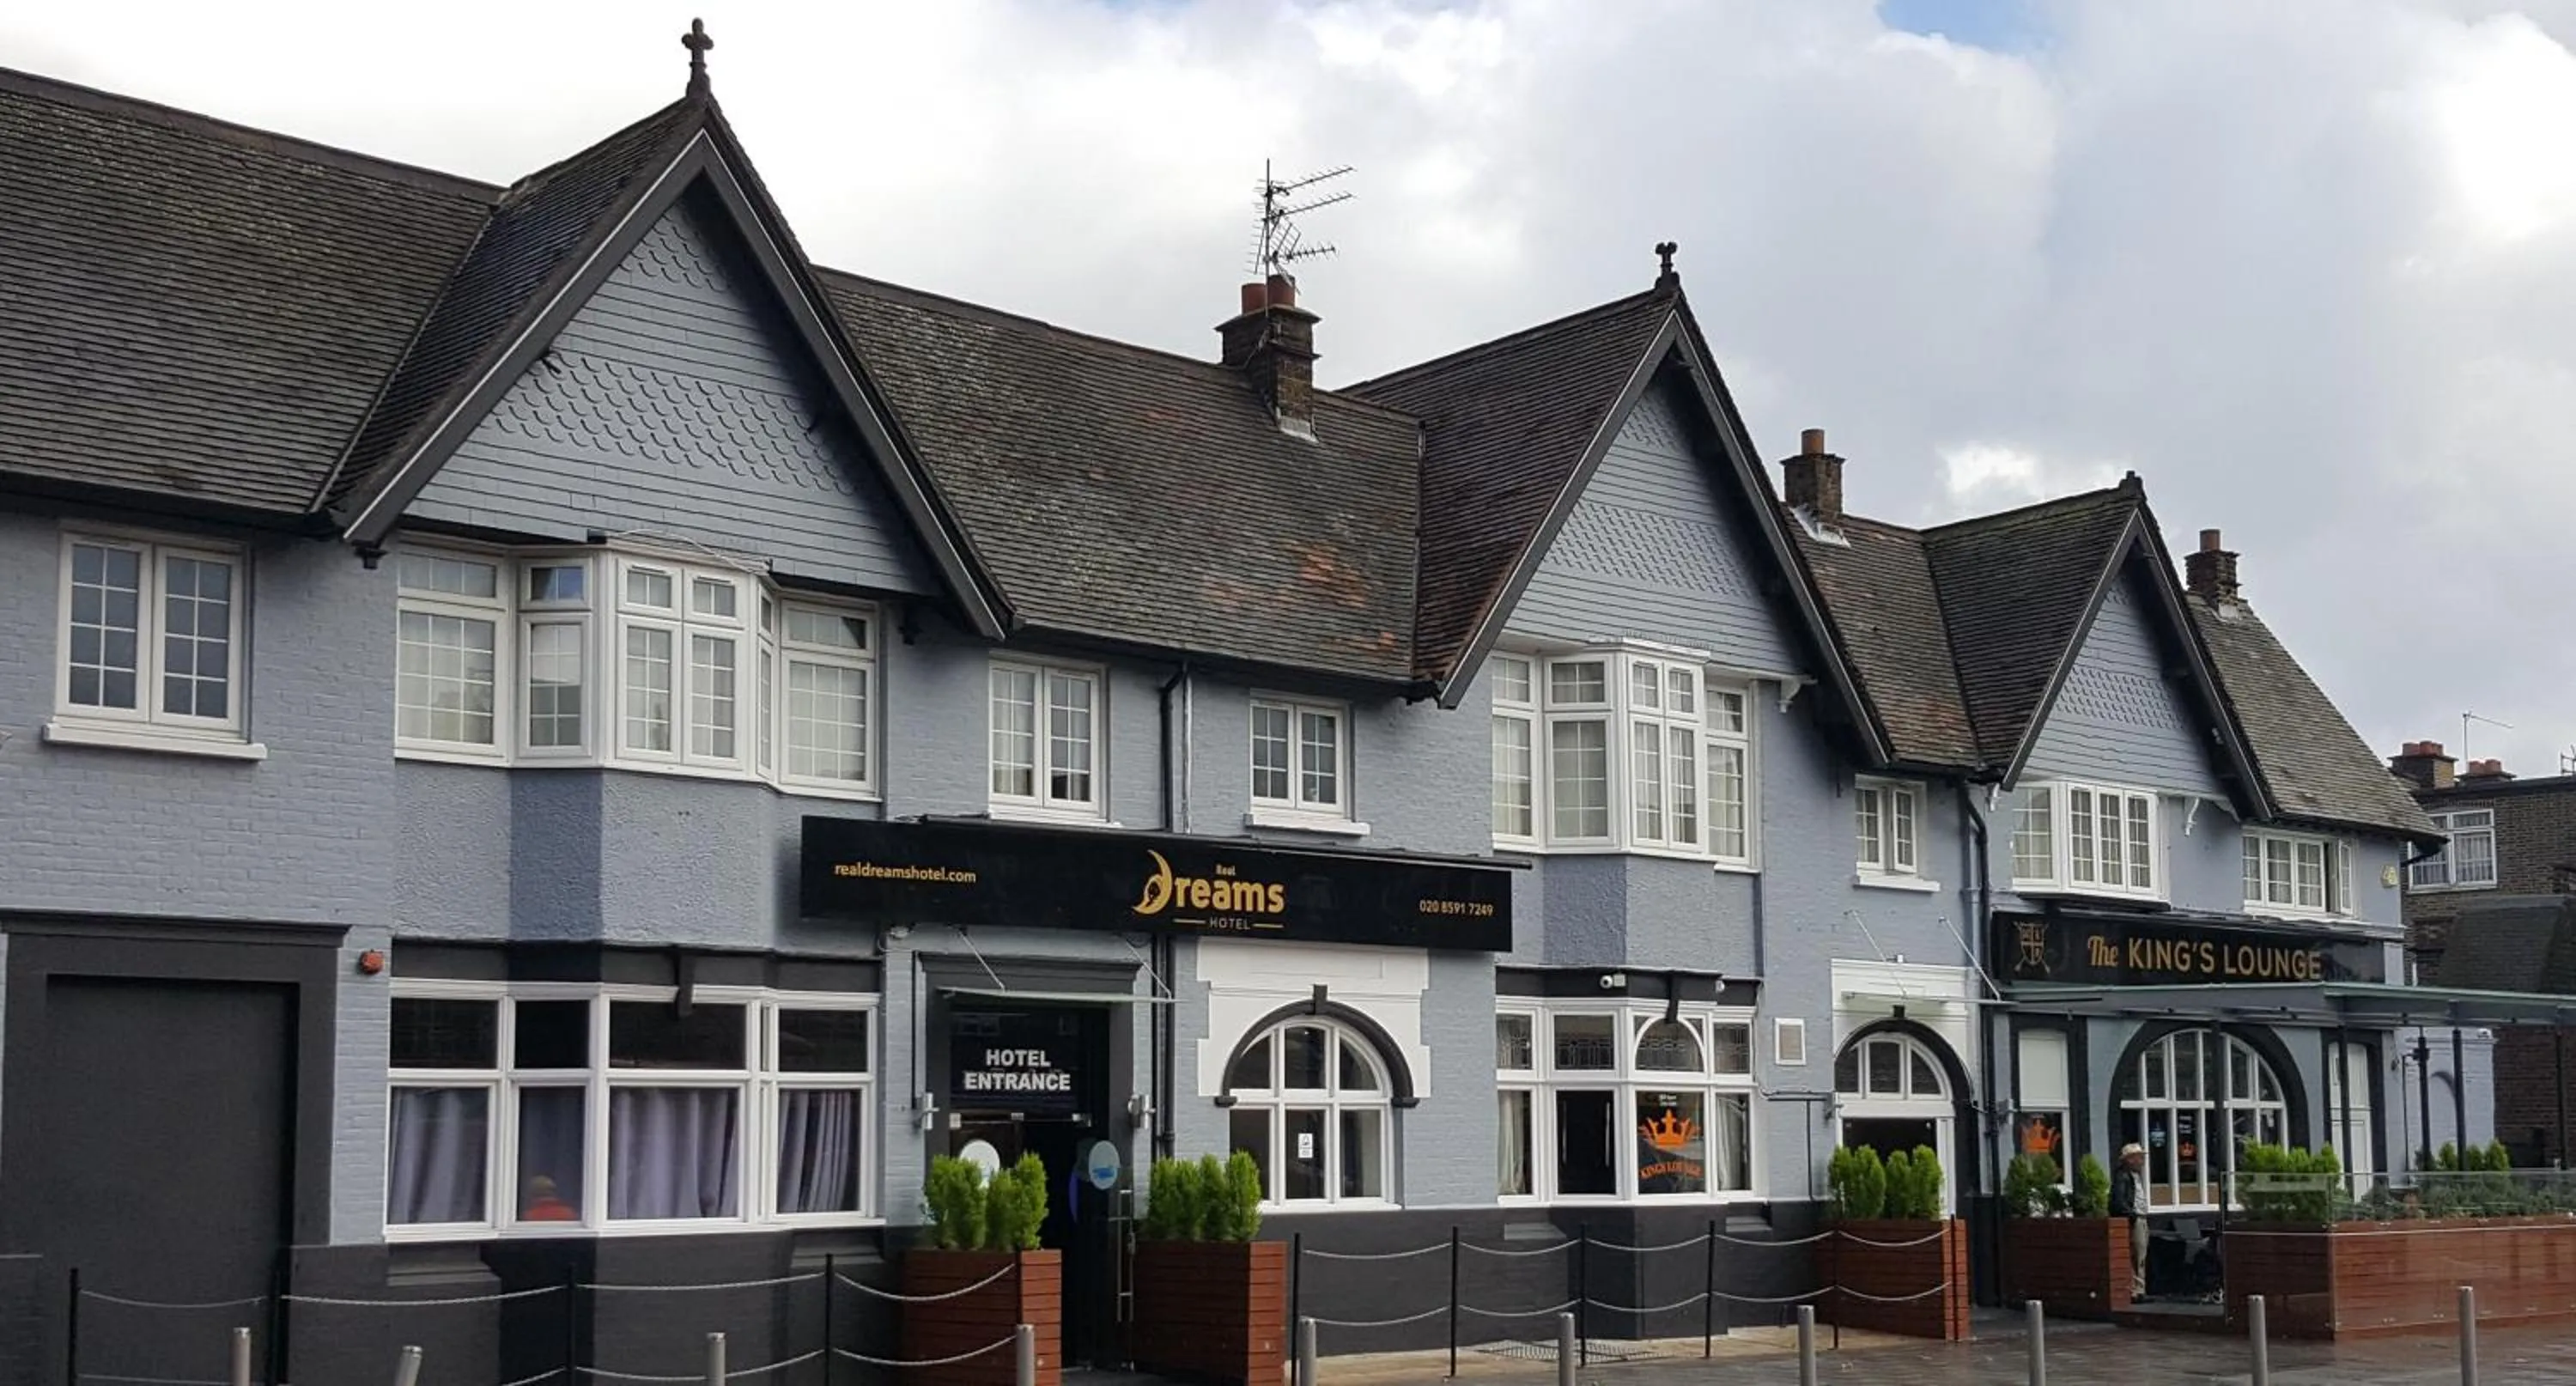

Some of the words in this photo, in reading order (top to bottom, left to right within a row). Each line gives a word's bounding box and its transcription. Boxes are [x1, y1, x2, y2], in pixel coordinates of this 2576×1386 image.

[835, 862, 976, 883] realdreamshotel.com
[1216, 864, 1236, 876] Real
[1419, 899, 1439, 913] 020
[1441, 901, 1466, 915] 8591
[1468, 903, 1494, 916] 7249
[1210, 917, 1250, 930] HOTEL
[2088, 935, 2118, 966] The
[2129, 937, 2215, 973] KING'S
[2223, 945, 2323, 979] LOUNGE
[986, 1049, 1051, 1067] HOTEL
[964, 1072, 1071, 1091] ENTRANCE
